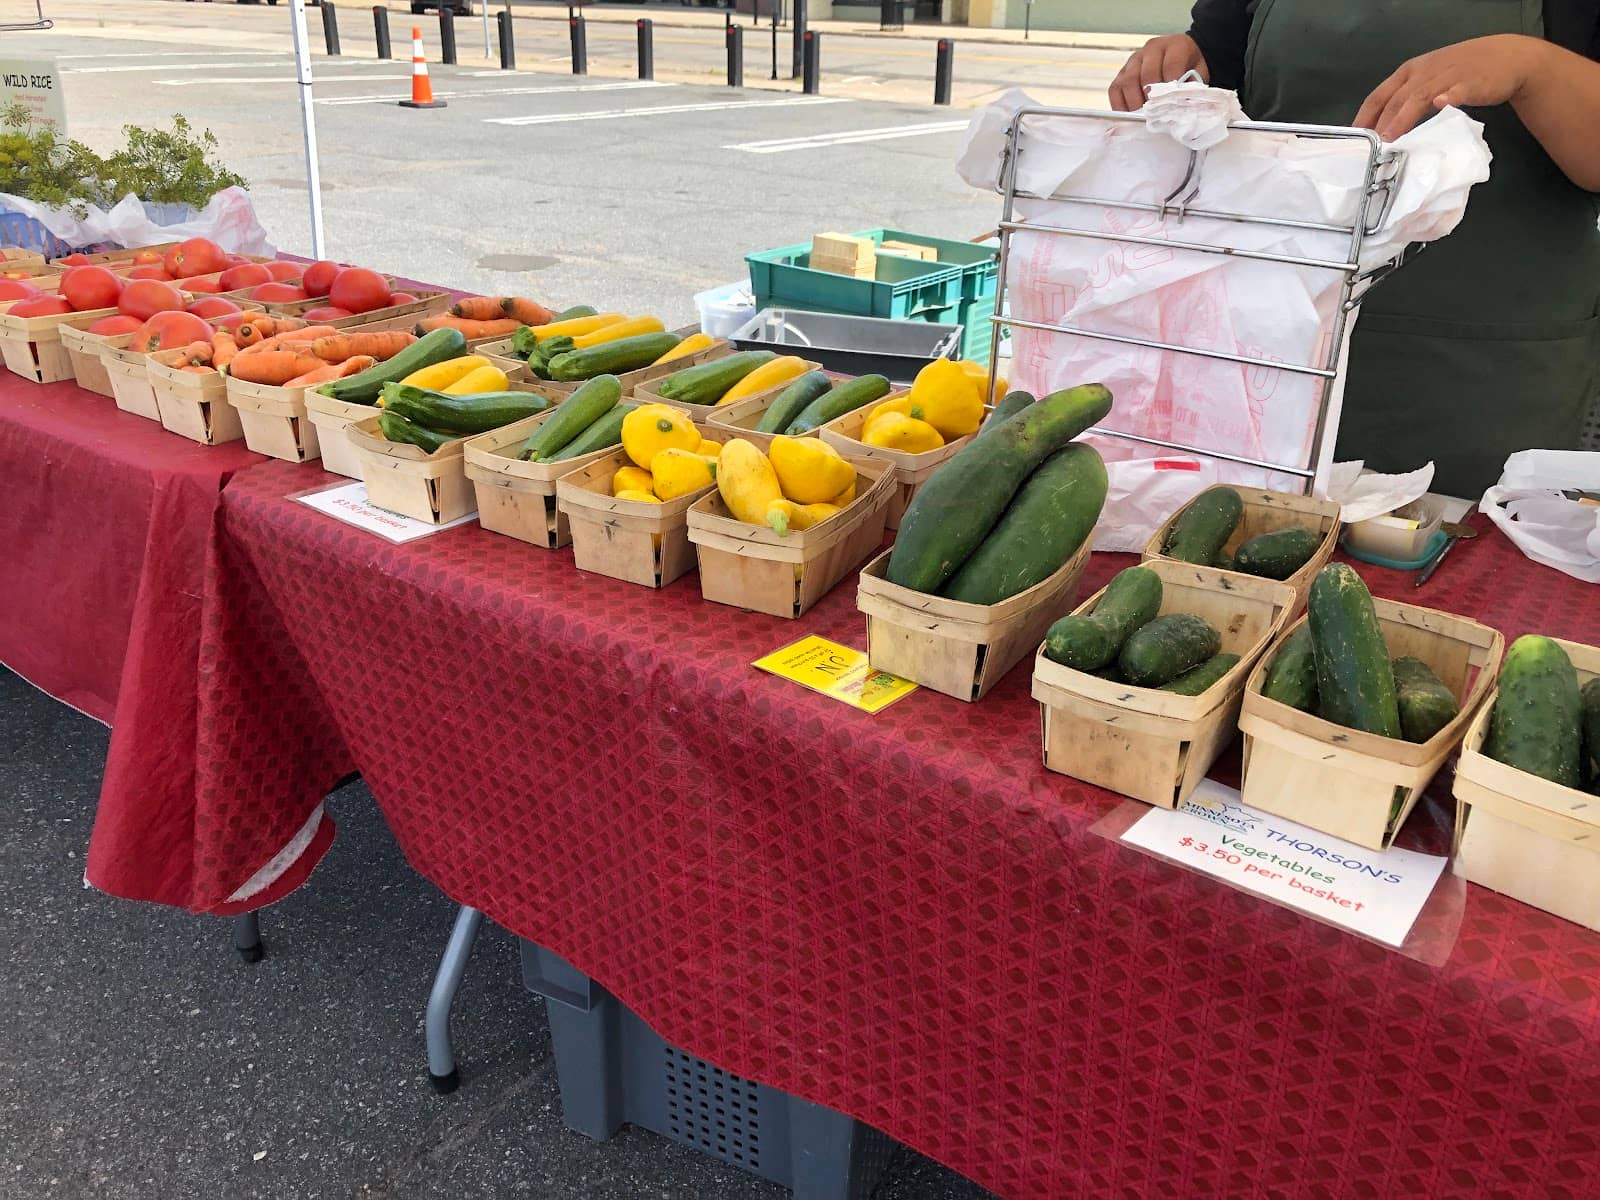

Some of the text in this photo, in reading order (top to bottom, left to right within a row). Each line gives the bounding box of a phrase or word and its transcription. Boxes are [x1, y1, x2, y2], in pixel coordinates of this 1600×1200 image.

[3, 74, 53, 90] WILD RICE
[1185, 800, 1256, 830] MINNESOTA
[1178, 836, 1366, 912] $3.50 per basket
[1220, 834, 1337, 885] Vegetables
[1264, 827, 1403, 885] THORSON'S
